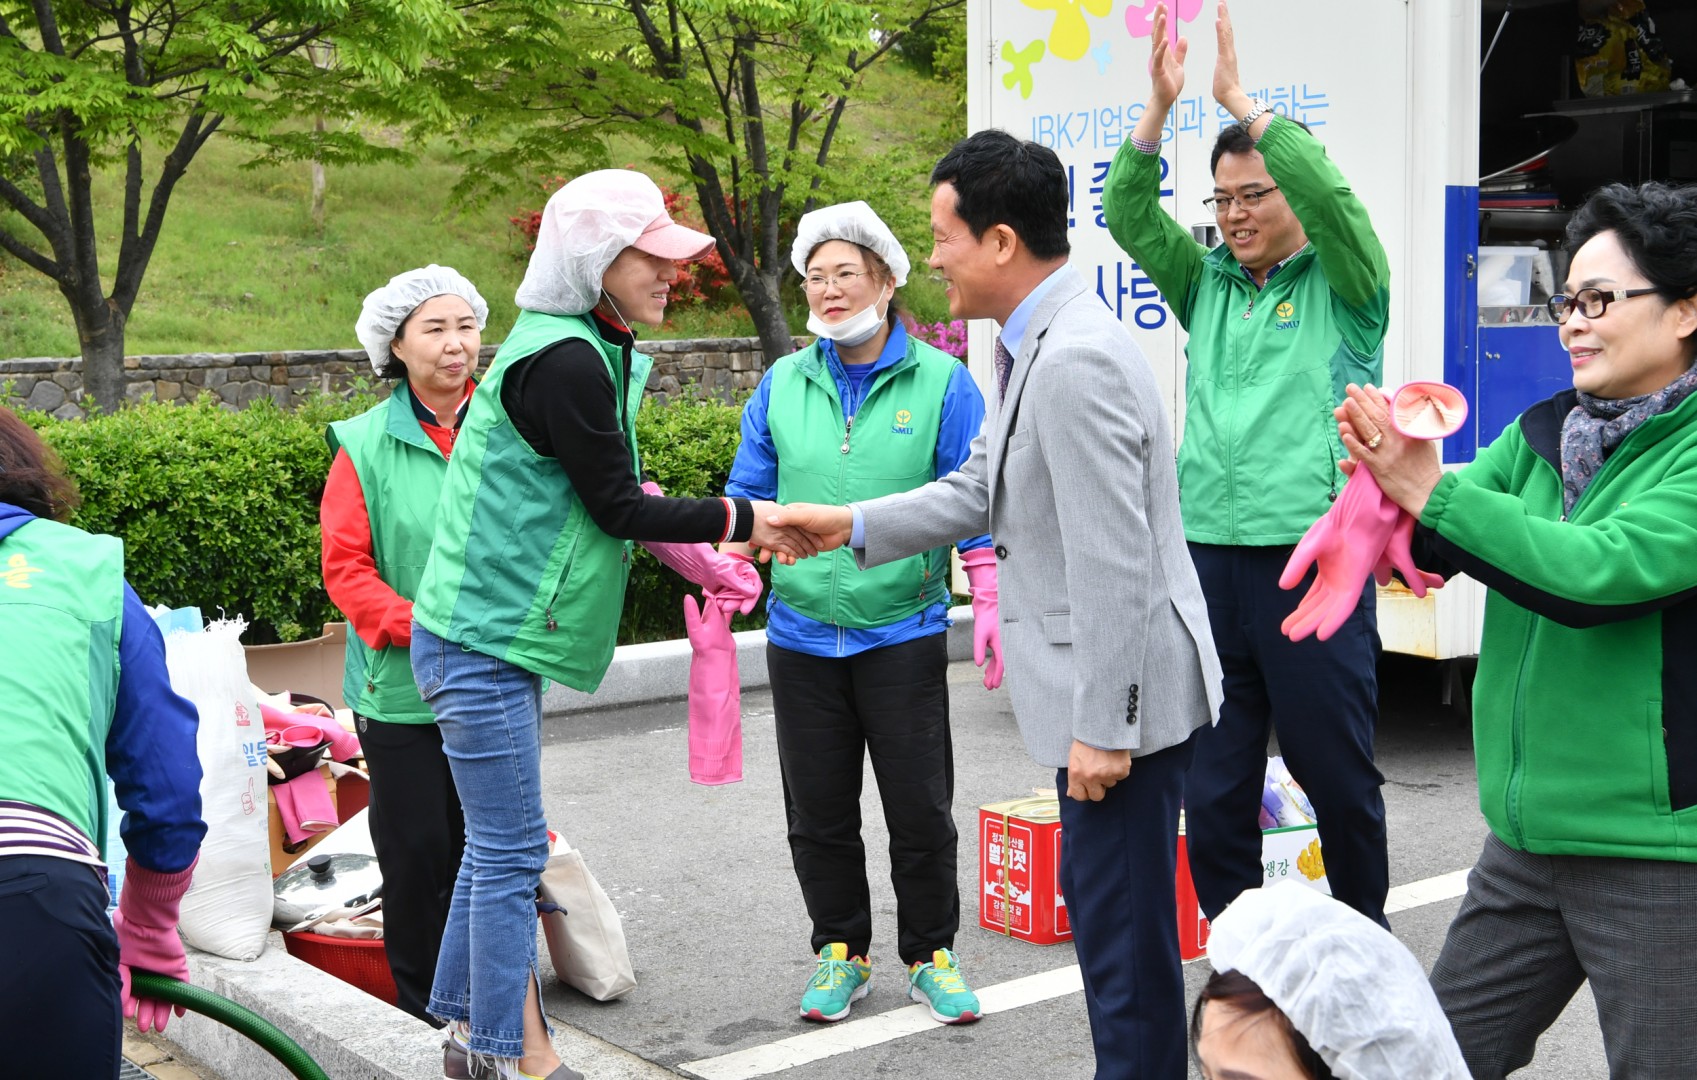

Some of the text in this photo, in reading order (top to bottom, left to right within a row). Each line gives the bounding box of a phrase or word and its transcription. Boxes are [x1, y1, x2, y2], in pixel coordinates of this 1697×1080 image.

[1032, 95, 1206, 149] IBK기업과
[1275, 320, 1300, 331] SMU
[1264, 858, 1290, 878] 생강
